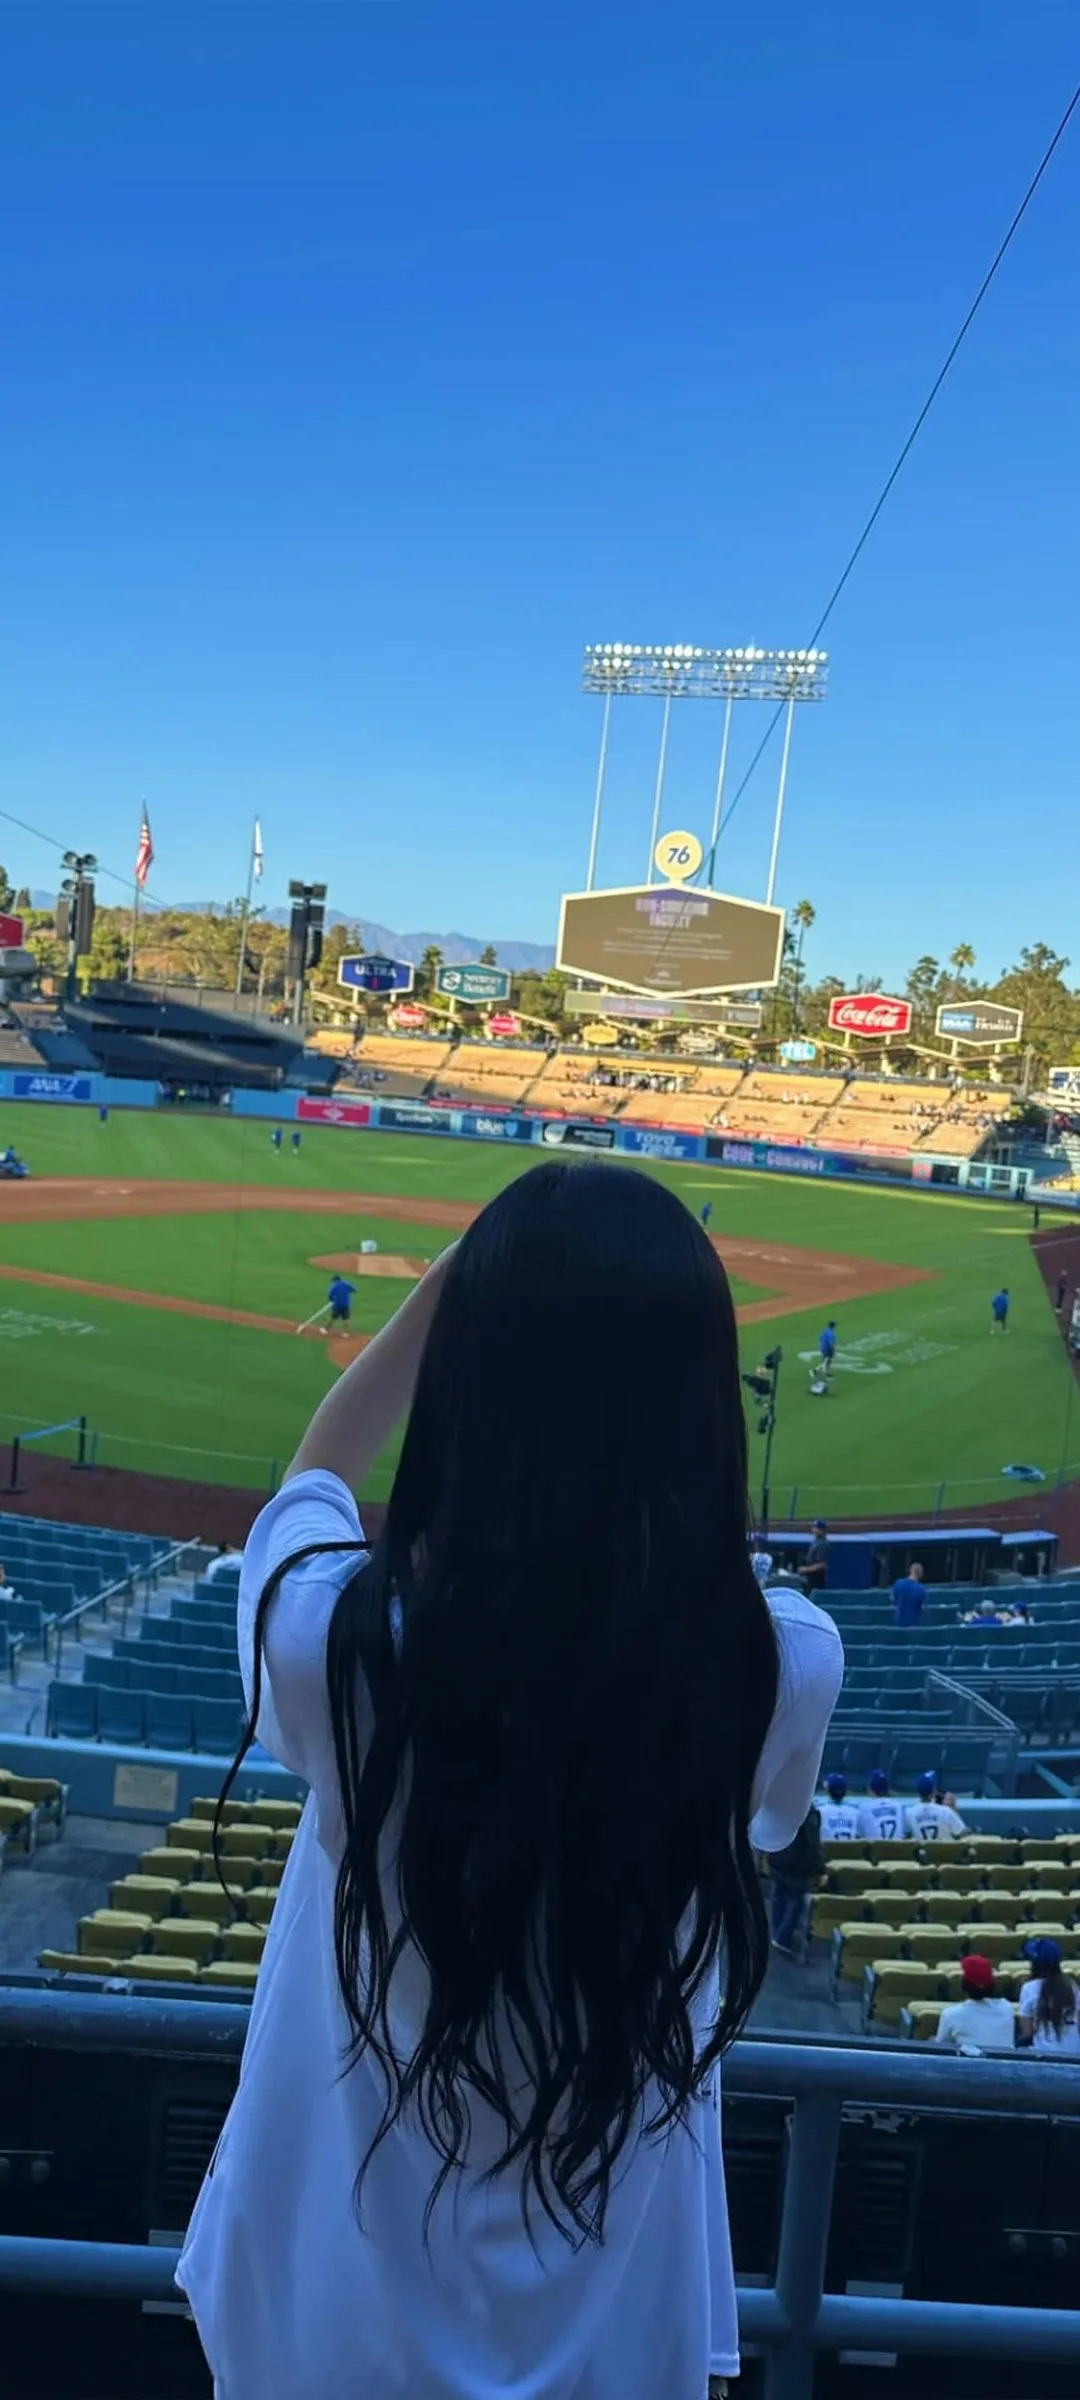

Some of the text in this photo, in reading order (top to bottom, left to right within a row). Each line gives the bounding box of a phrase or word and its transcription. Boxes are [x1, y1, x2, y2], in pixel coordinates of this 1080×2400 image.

[667, 846, 691, 865] 76
[355, 963, 397, 979] ULTRA
[880, 1820, 897, 1840] 17
[919, 1825, 939, 1841] 17
